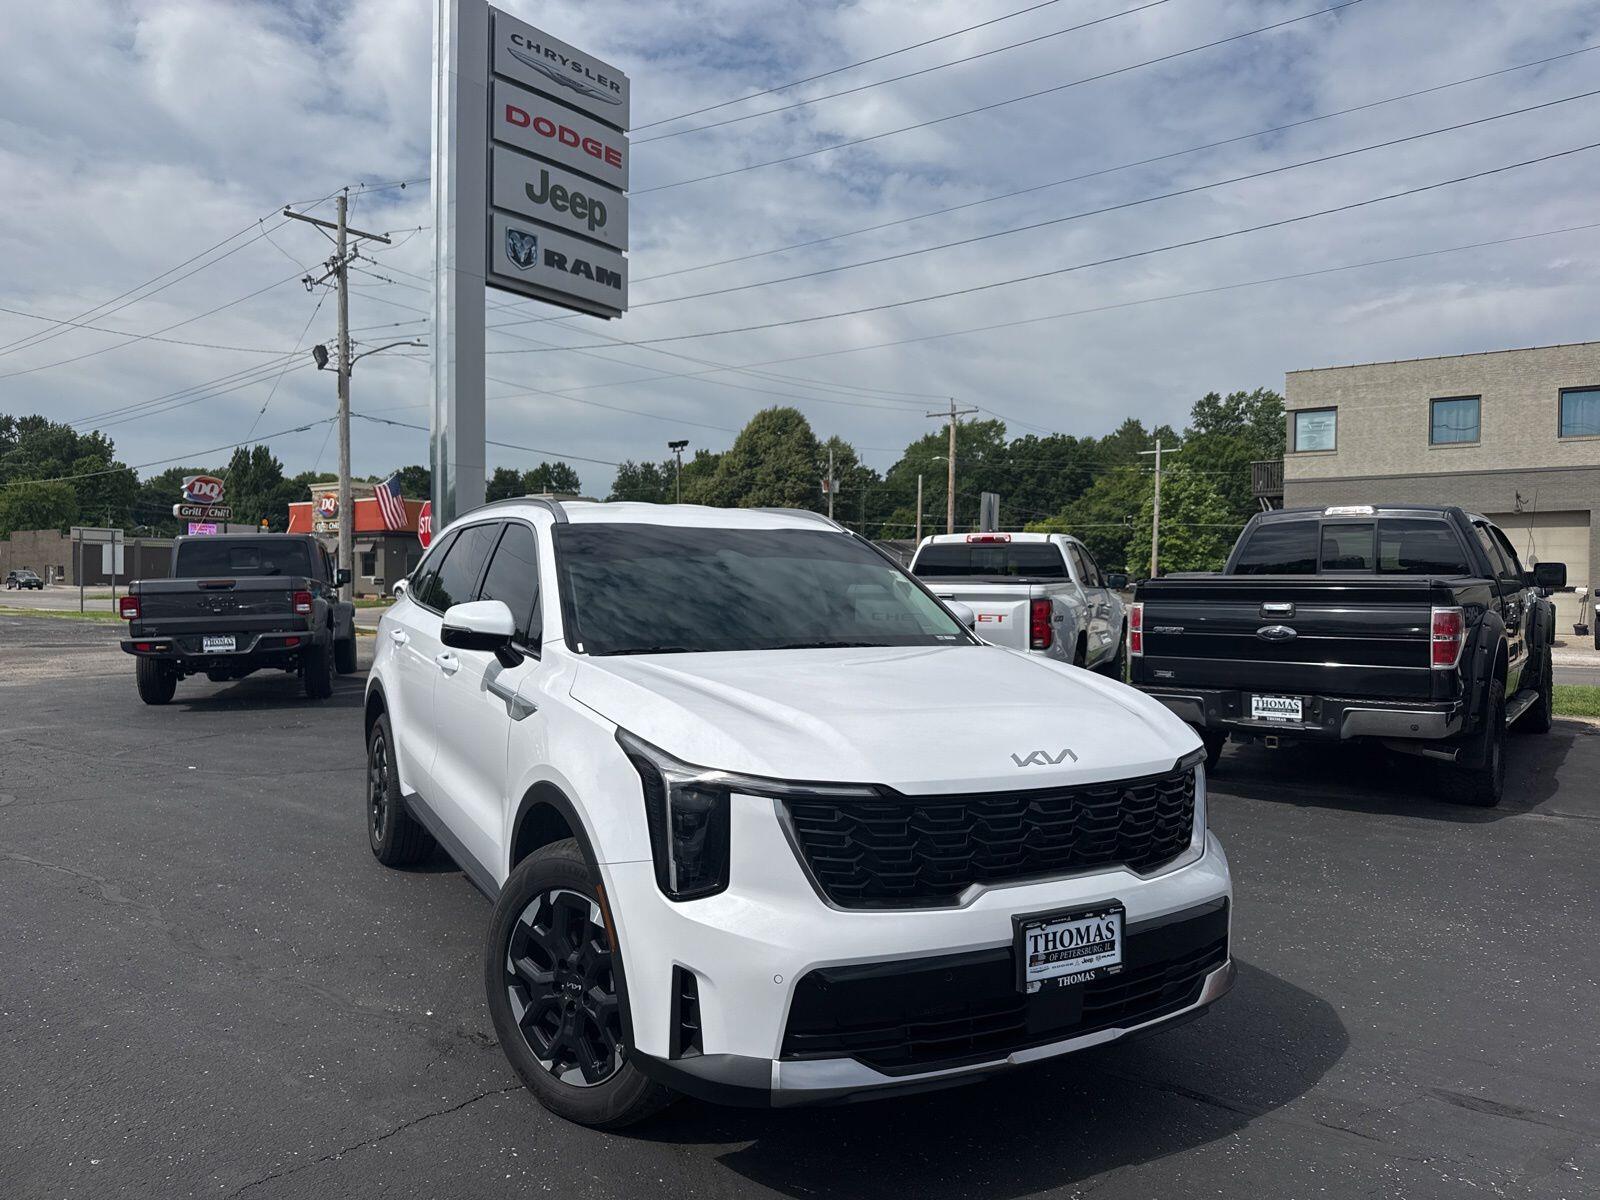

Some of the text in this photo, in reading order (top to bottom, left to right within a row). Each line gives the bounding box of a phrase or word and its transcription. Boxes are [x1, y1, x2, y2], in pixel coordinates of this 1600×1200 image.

[510, 33, 621, 94] CHRYSLER
[506, 104, 622, 169] DODGE
[525, 169, 607, 230] Jeep
[543, 248, 621, 290] RAM
[192, 481, 219, 498] DQ
[181, 507, 202, 516] Grill
[321, 498, 335, 512] DQ
[204, 637, 235, 648] THOMAS
[1253, 698, 1300, 709] THOMAS
[1029, 920, 1115, 955] THOMAS
[1049, 953, 1058, 962] OF
[1104, 942, 1112, 951] IL
[1057, 970, 1096, 987] THOMAS
